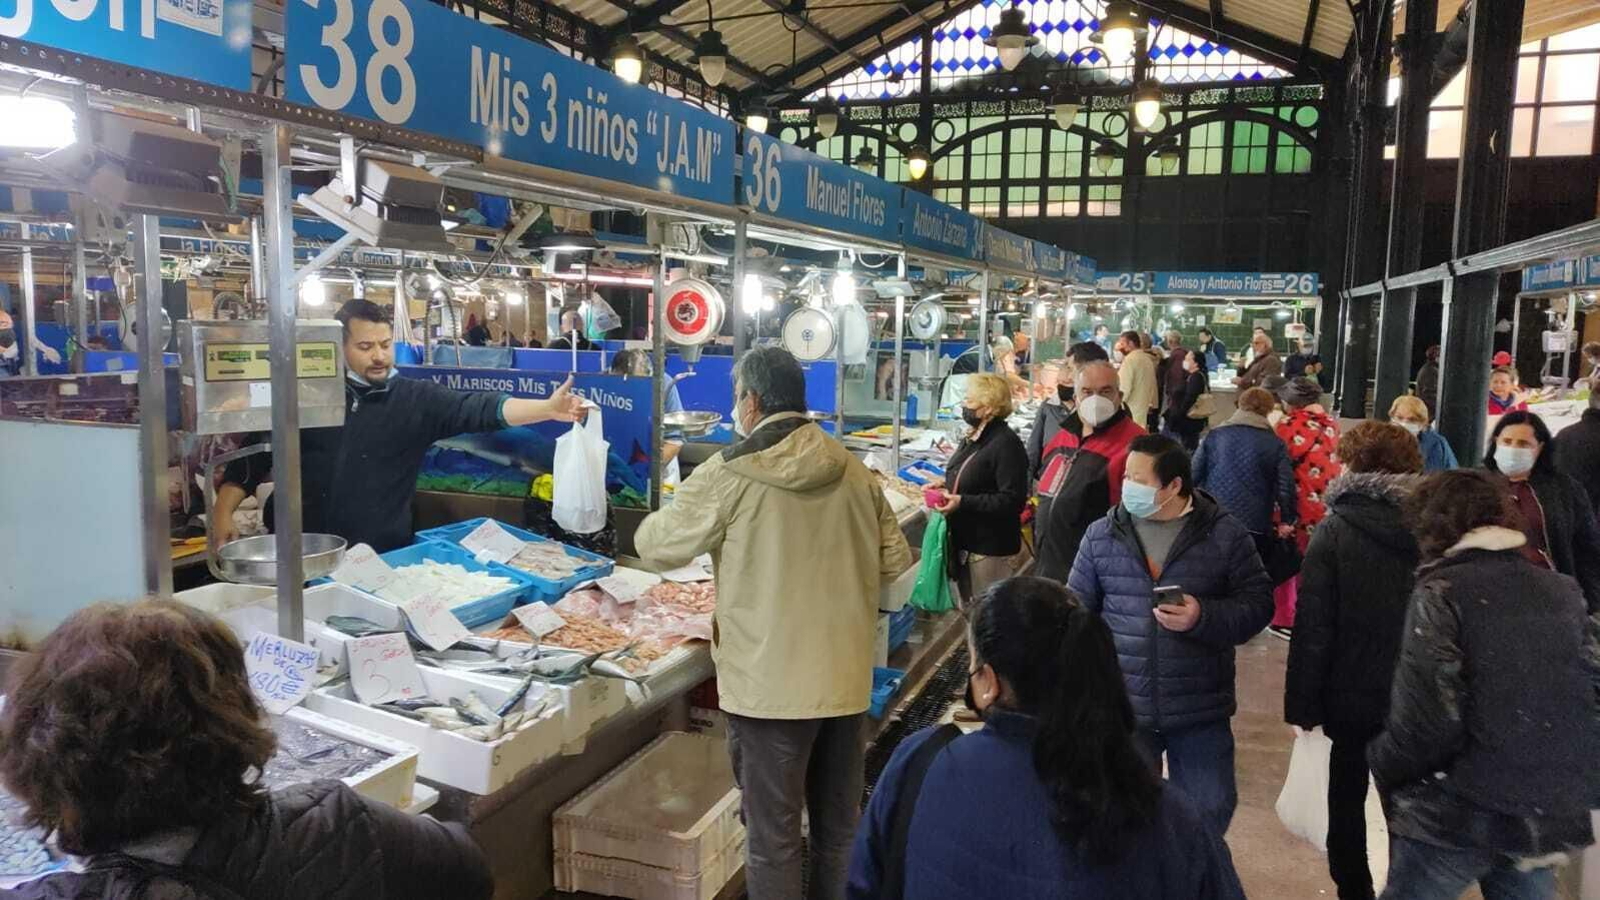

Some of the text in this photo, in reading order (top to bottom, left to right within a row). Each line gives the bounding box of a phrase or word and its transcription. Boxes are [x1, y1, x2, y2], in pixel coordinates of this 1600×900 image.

[299, 0, 417, 125] 38
[470, 45, 530, 136] Mis
[540, 72, 558, 144] 3
[567, 86, 637, 165] niños
[746, 135, 885, 226] 36 Manuel Flores
[1120, 272, 1145, 292] 25
[1167, 273, 1314, 294] Alonso y Antonio Flores 26
[550, 380, 585, 398] TES
